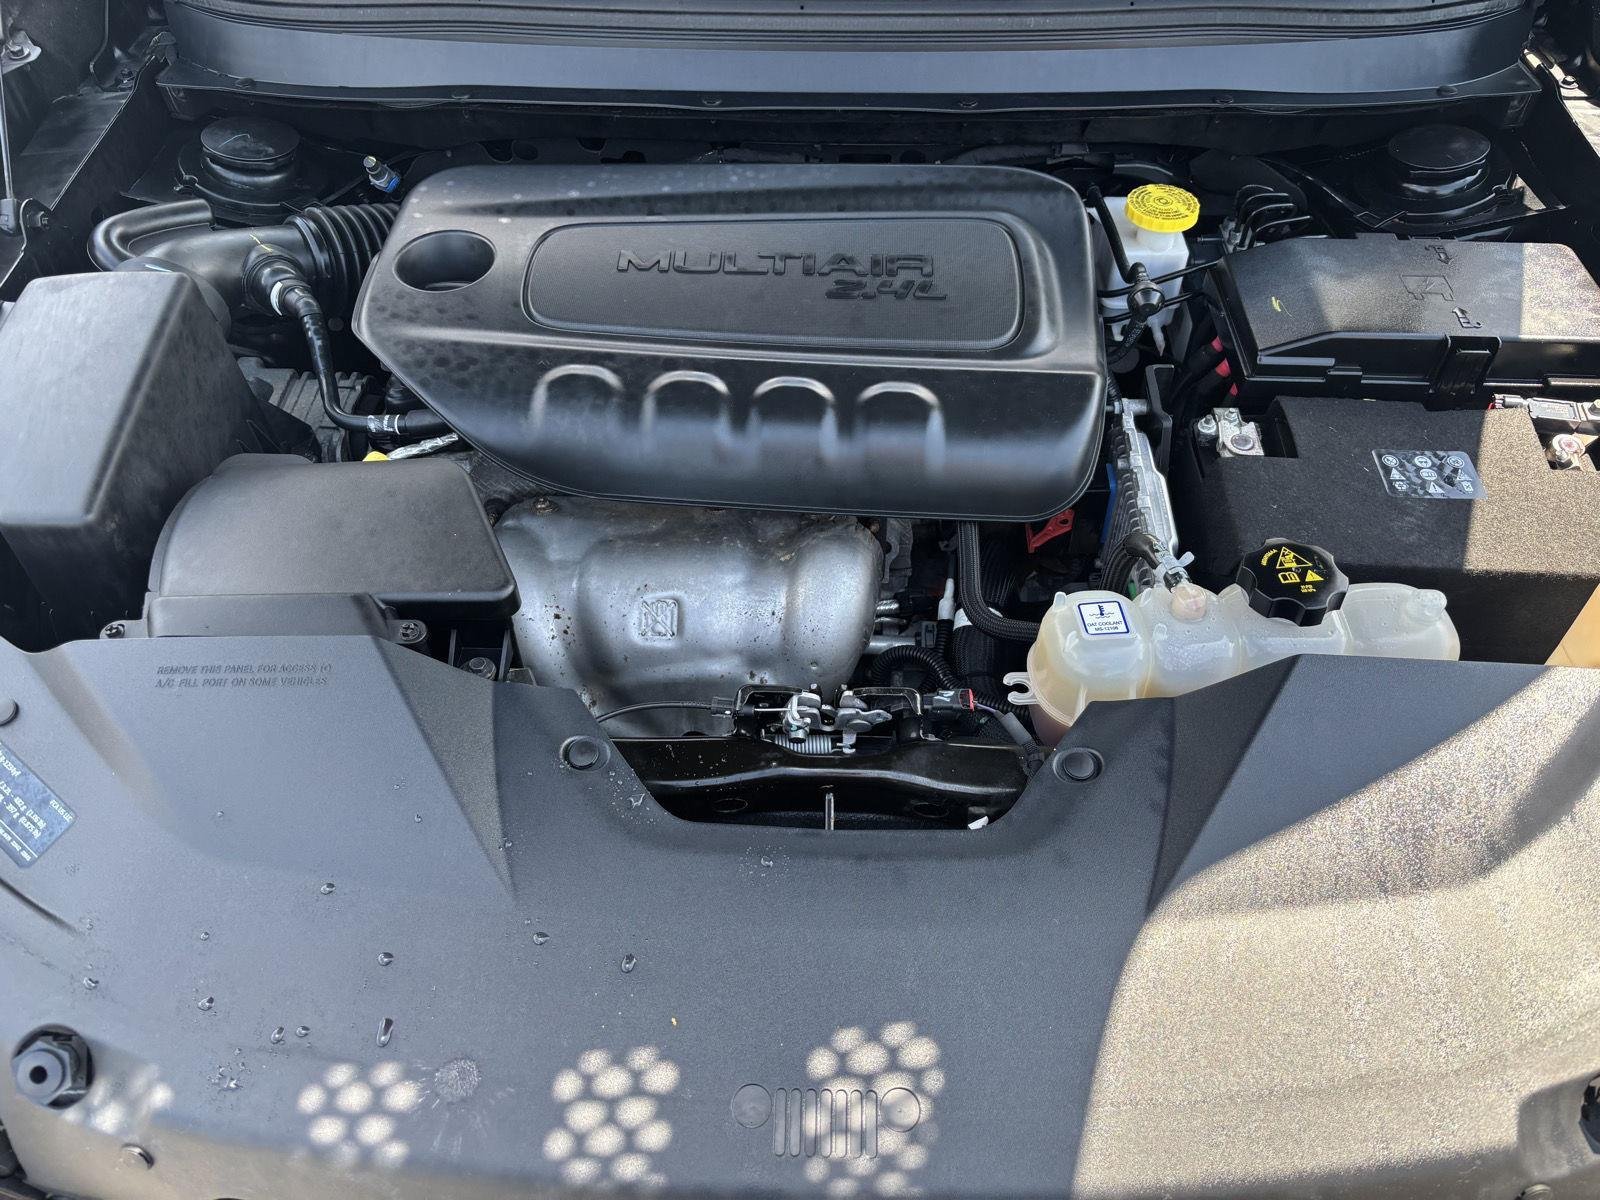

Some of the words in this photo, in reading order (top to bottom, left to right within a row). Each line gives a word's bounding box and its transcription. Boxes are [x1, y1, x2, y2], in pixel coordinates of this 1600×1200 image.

[616, 249, 934, 277] MULTIAIR
[824, 279, 947, 300] 2.4L
[157, 665, 198, 675] REMOVE
[200, 664, 222, 674] THIS
[224, 664, 254, 673] PANEL
[258, 664, 278, 673] FOR
[178, 678, 198, 688] FILL
[202, 678, 229, 688] PORT
[231, 677, 247, 687] ON
[248, 677, 277, 687] SOME
